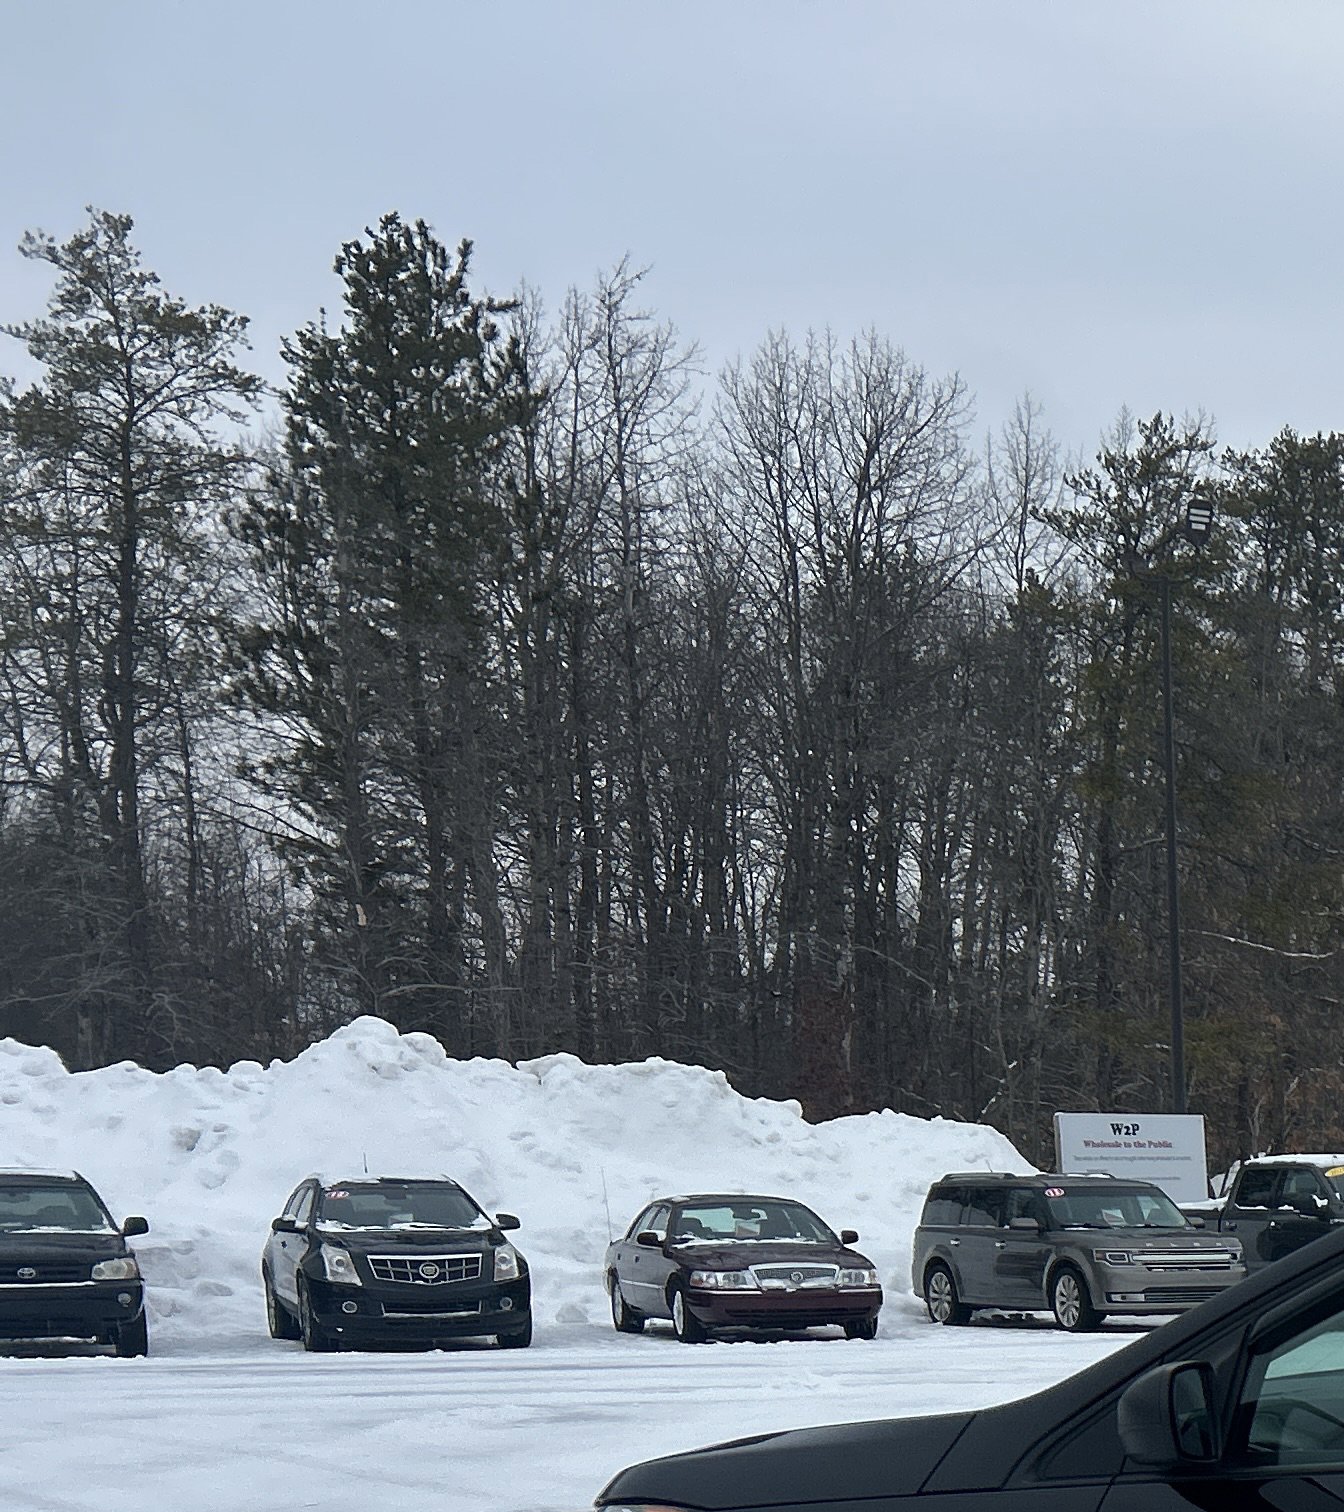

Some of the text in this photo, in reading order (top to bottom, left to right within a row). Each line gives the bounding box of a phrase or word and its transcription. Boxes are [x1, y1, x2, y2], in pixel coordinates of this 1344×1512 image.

[1110, 1123, 1140, 1136] W2P
[1083, 1140, 1173, 1149] Wholesale to the Public
